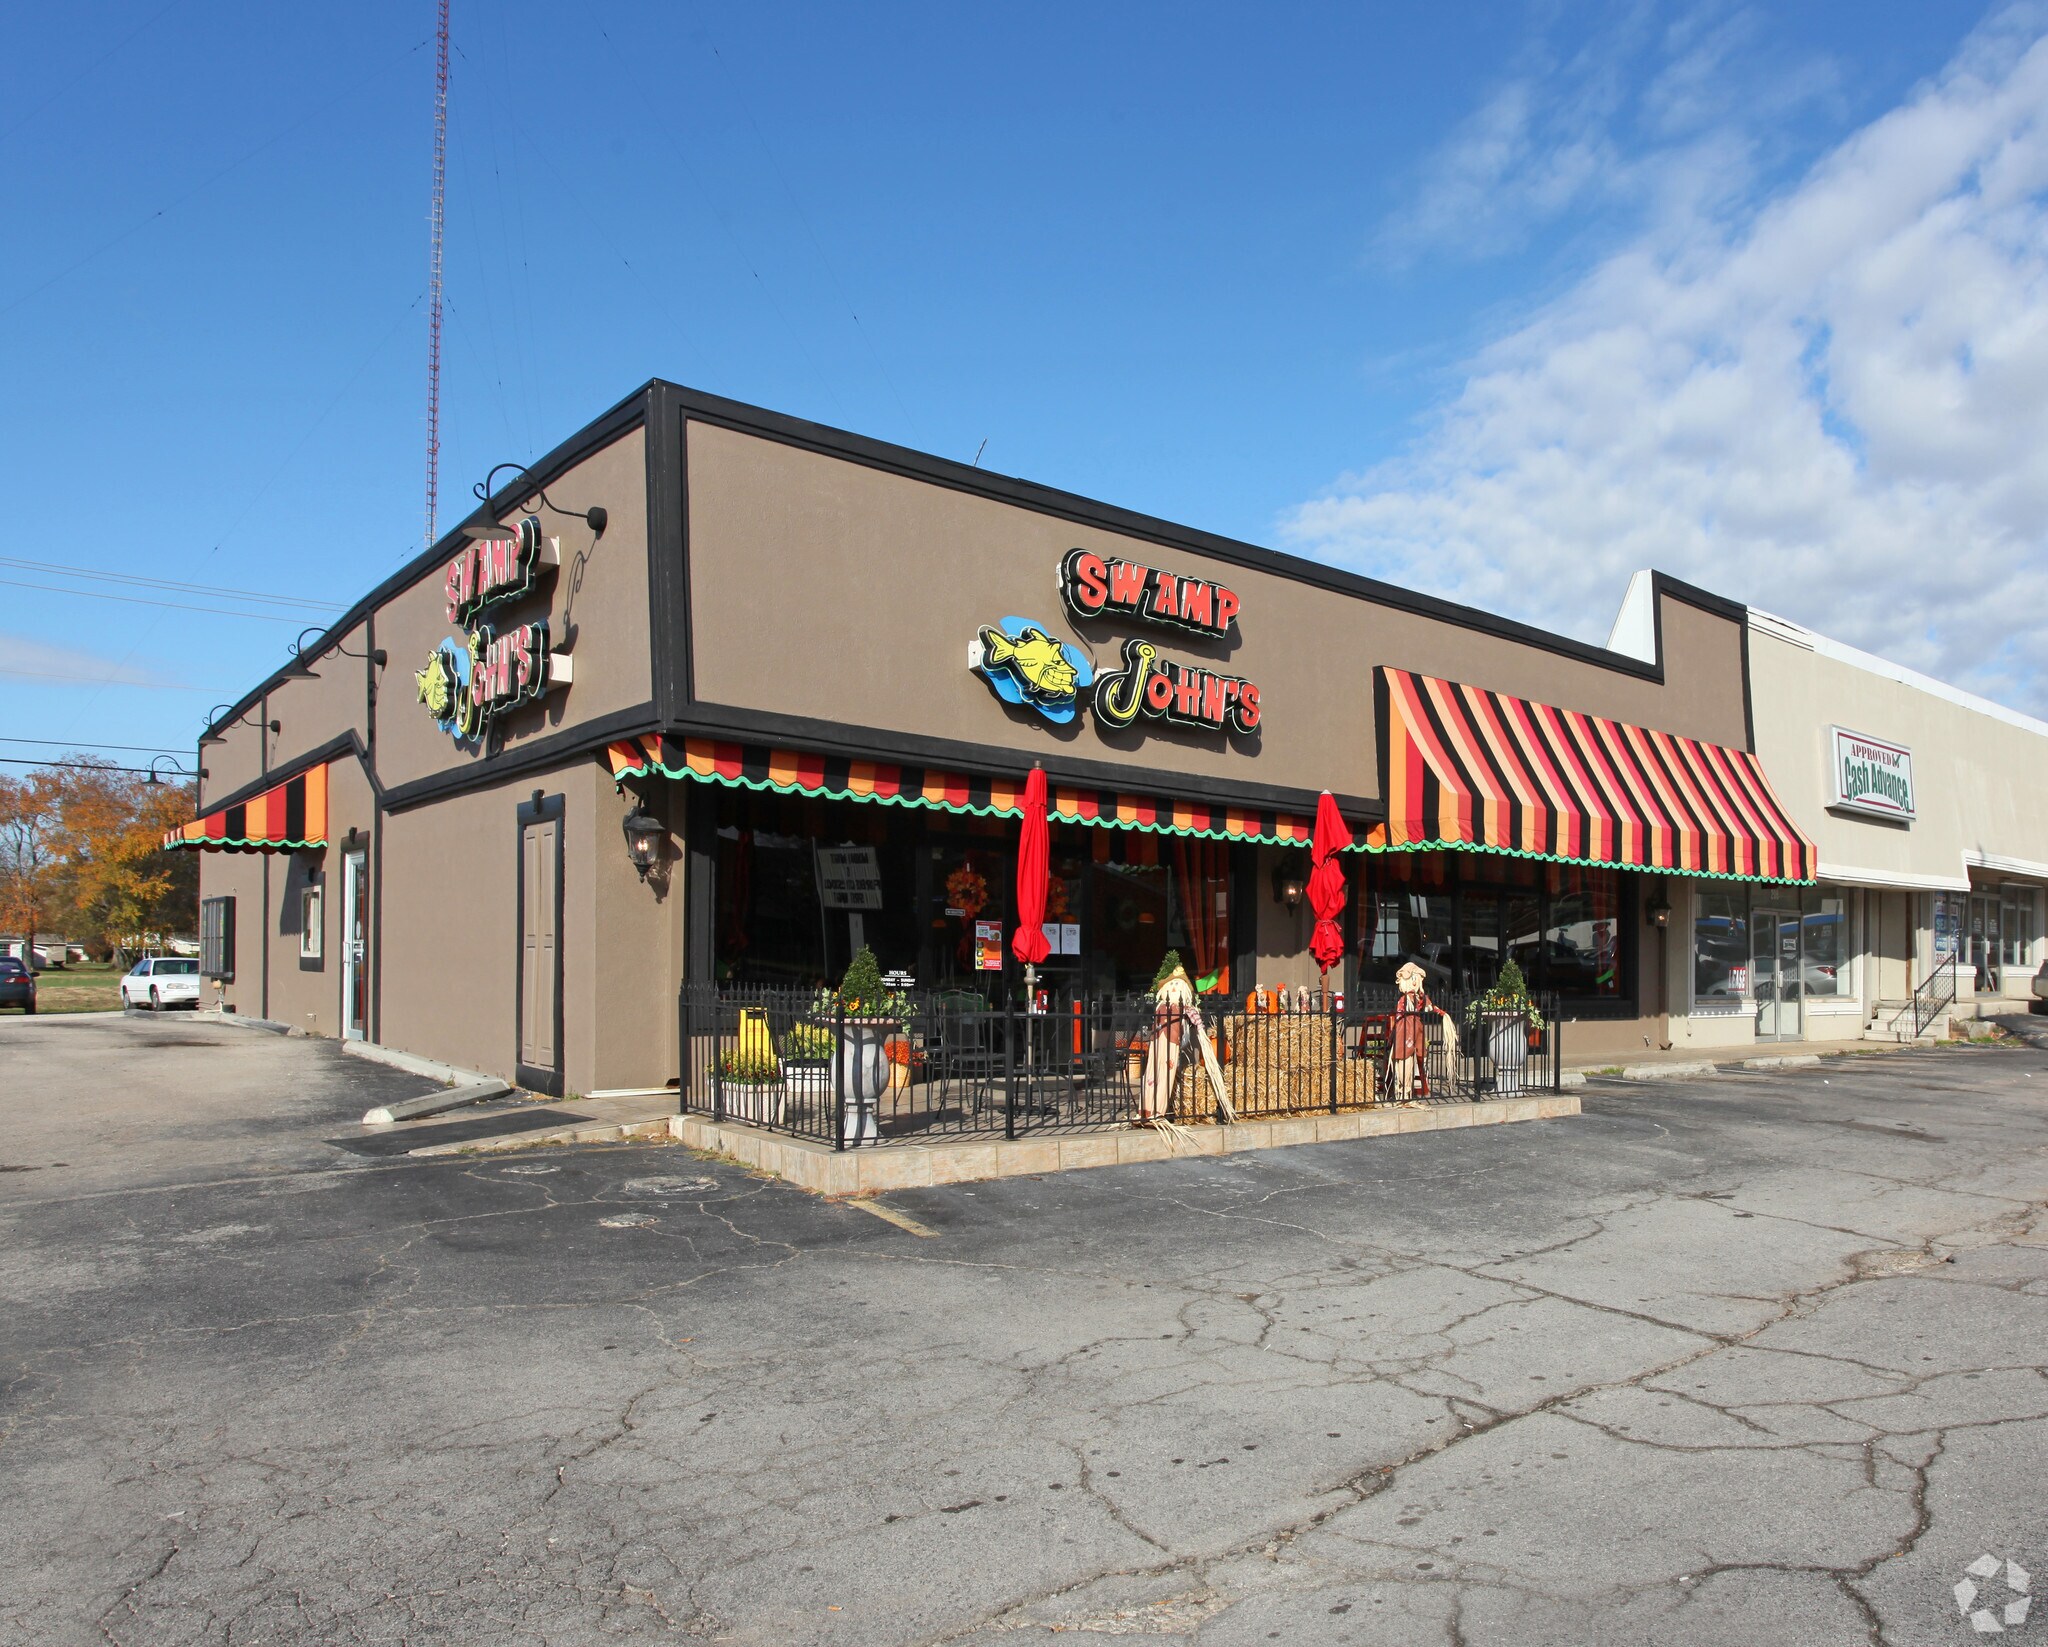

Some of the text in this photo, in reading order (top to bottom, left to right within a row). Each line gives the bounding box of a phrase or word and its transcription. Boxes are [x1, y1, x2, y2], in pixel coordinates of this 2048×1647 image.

[1076, 553, 1240, 630] SWAMP
[1104, 643, 1260, 727] JOHN'S
[1844, 756, 1910, 814] Cash Advance
[1850, 743, 1892, 766] APPROVED
